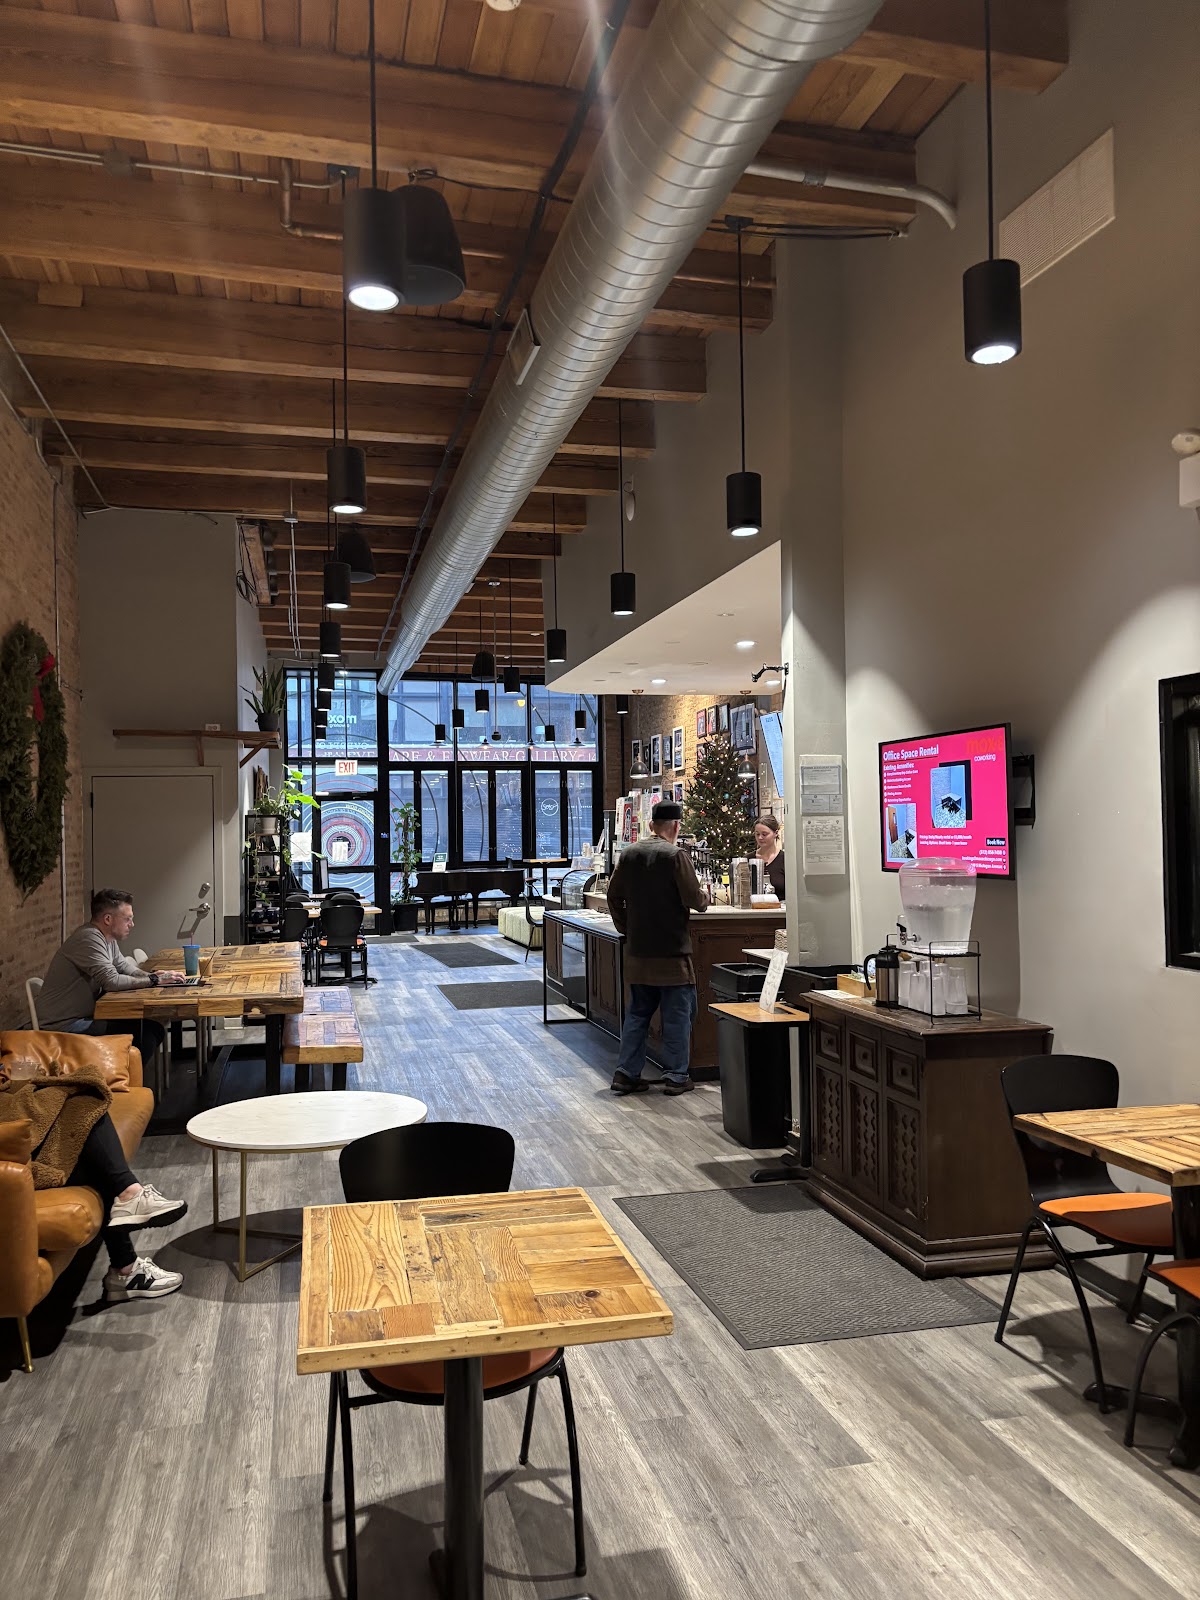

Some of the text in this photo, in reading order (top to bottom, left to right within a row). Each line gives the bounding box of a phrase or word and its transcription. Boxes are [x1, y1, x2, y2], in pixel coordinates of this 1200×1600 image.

[884, 744, 939, 760] Office Space Rental
[338, 761, 355, 773] EXIT
